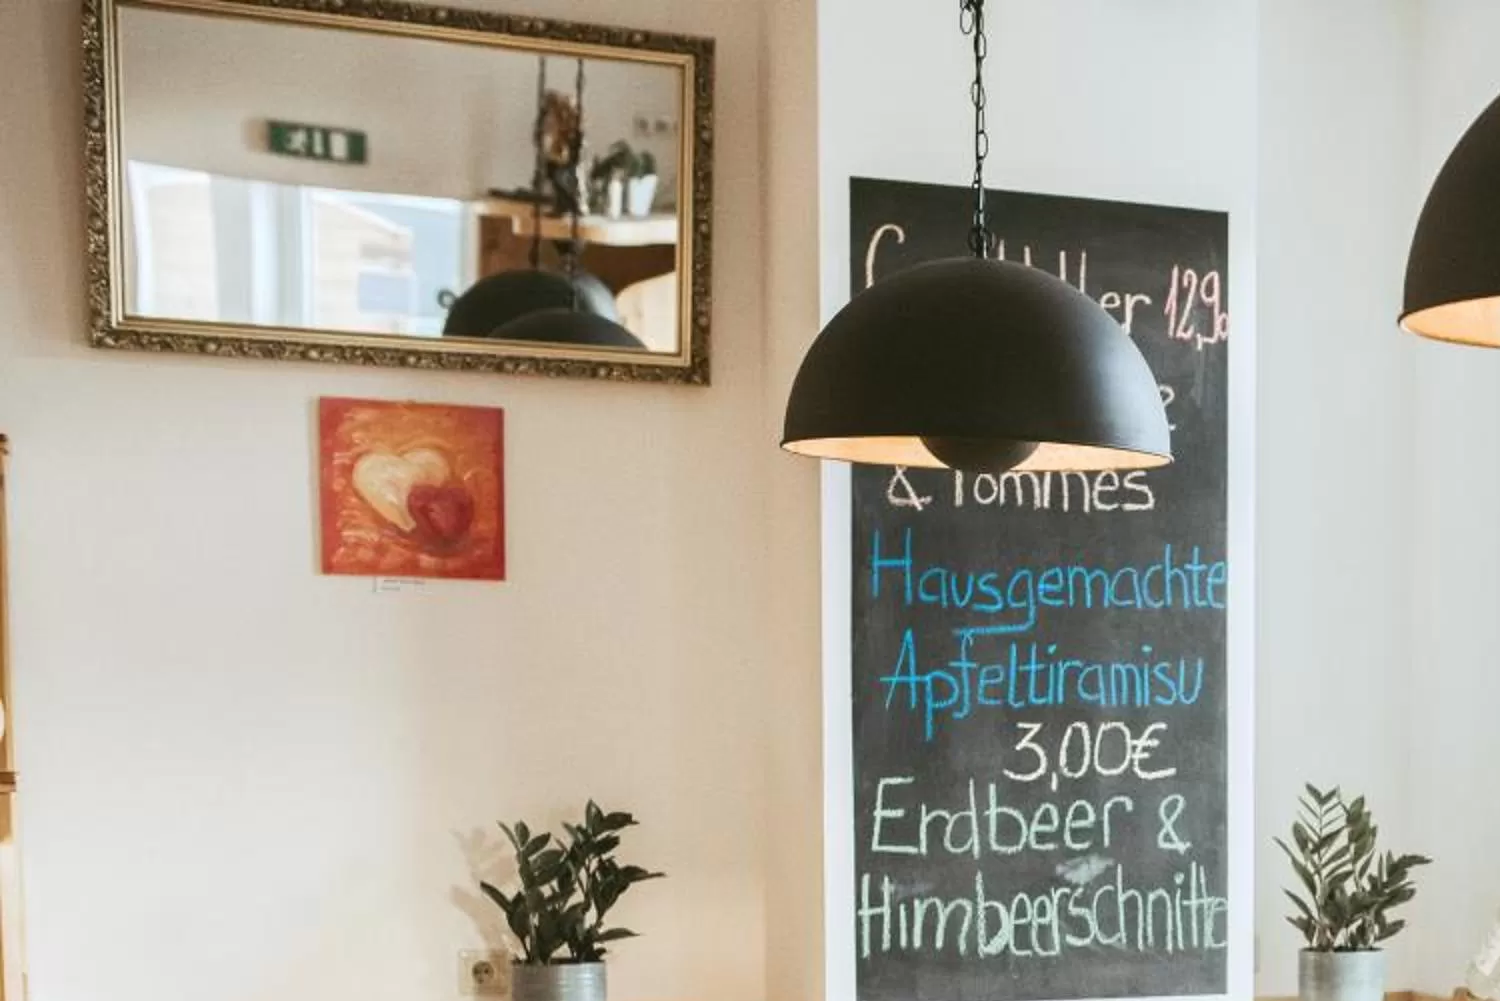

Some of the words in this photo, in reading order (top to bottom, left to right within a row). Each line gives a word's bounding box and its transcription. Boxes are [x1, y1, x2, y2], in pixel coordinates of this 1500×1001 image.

[872, 528, 1227, 634] Hausgemachte
[880, 628, 1204, 741] Apfeltiramisu
[1003, 721, 1176, 791] 3,00€
[871, 776, 1133, 859] Erdbeer
[1157, 794, 1192, 855] &
